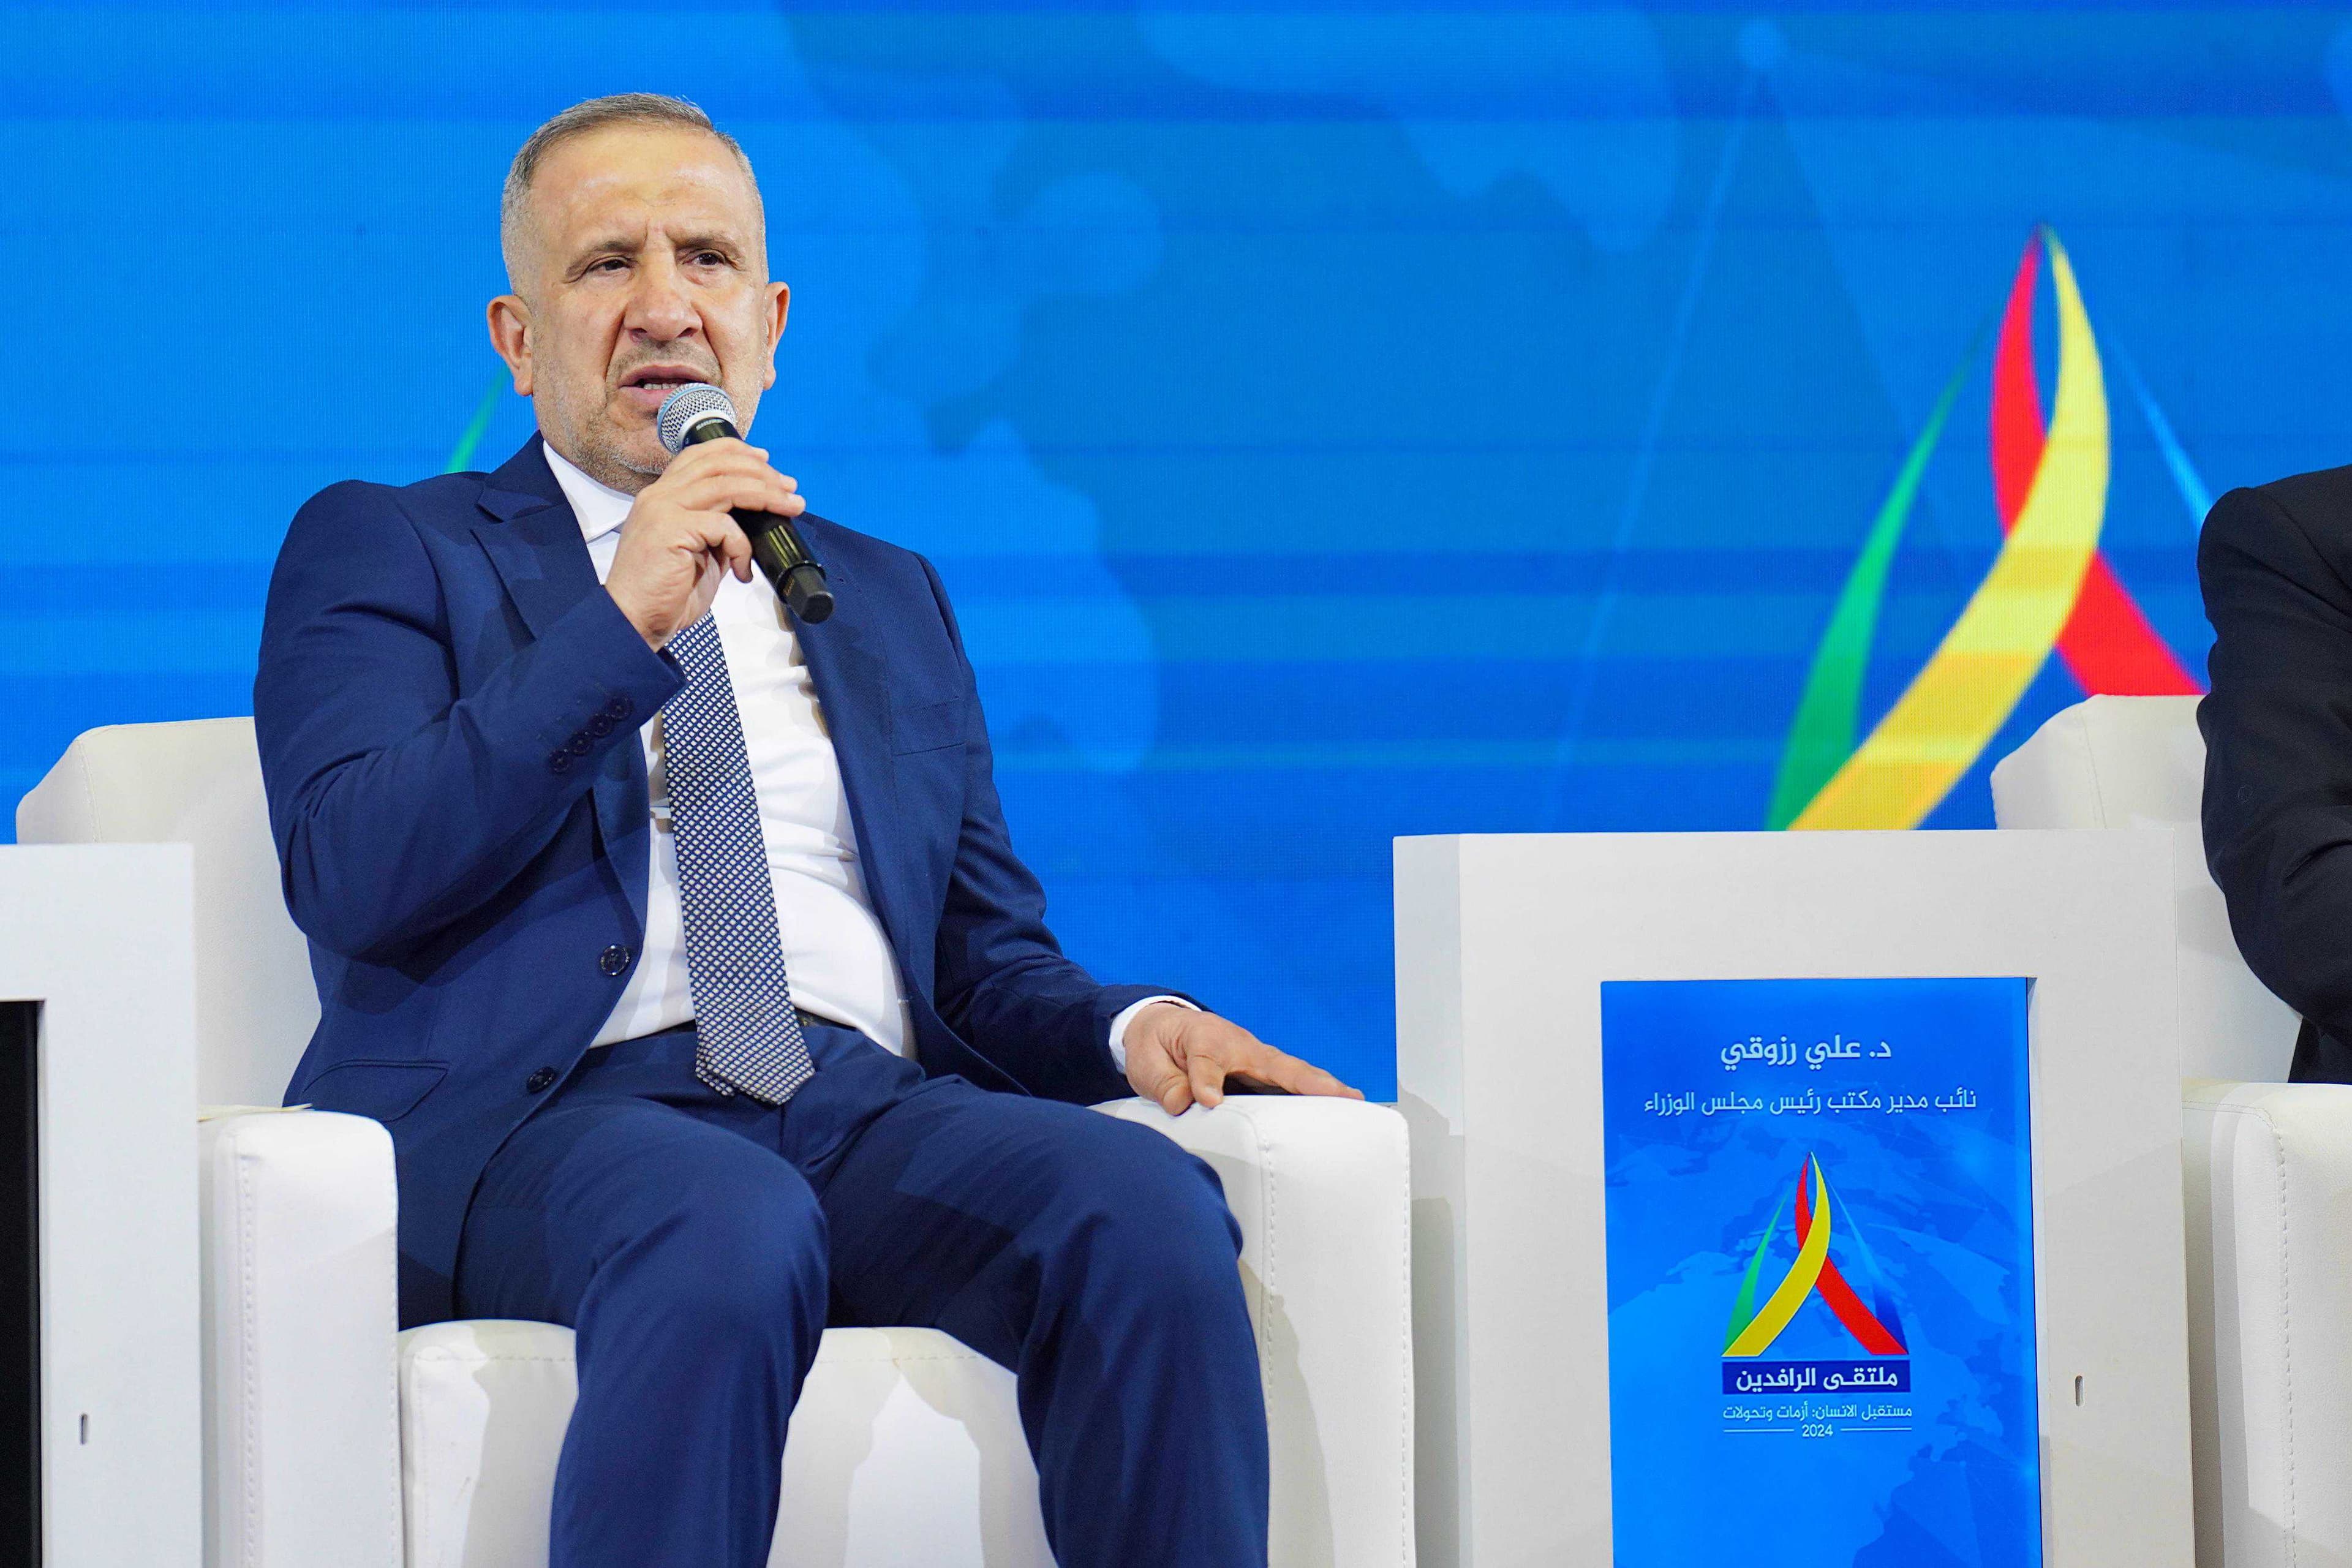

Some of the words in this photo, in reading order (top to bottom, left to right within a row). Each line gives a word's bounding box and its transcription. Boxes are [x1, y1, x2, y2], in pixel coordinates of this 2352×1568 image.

[1720, 1036, 1797, 1071] رزوقي
[1805, 1034, 1861, 1070] علي
[1869, 1041, 1892, 1058] د.
[1644, 1091, 1695, 1116] الوزراء
[1701, 1091, 1764, 1115] مجلس
[1770, 1088, 1822, 1115] رئيس
[1826, 1090, 1882, 1114] مكتب
[1886, 1095, 1929, 1114] مدير
[1935, 1087, 1977, 1112] نائب
[1736, 1368, 1817, 1393] الرافدين
[1823, 1366, 1898, 1390] ملتقى
[1722, 1406, 1773, 1422] وتحولات
[1776, 1400, 1809, 1421] أزمات
[1861, 1404, 1913, 1421] مستقبل
[1801, 1423, 1834, 1438] 2024
